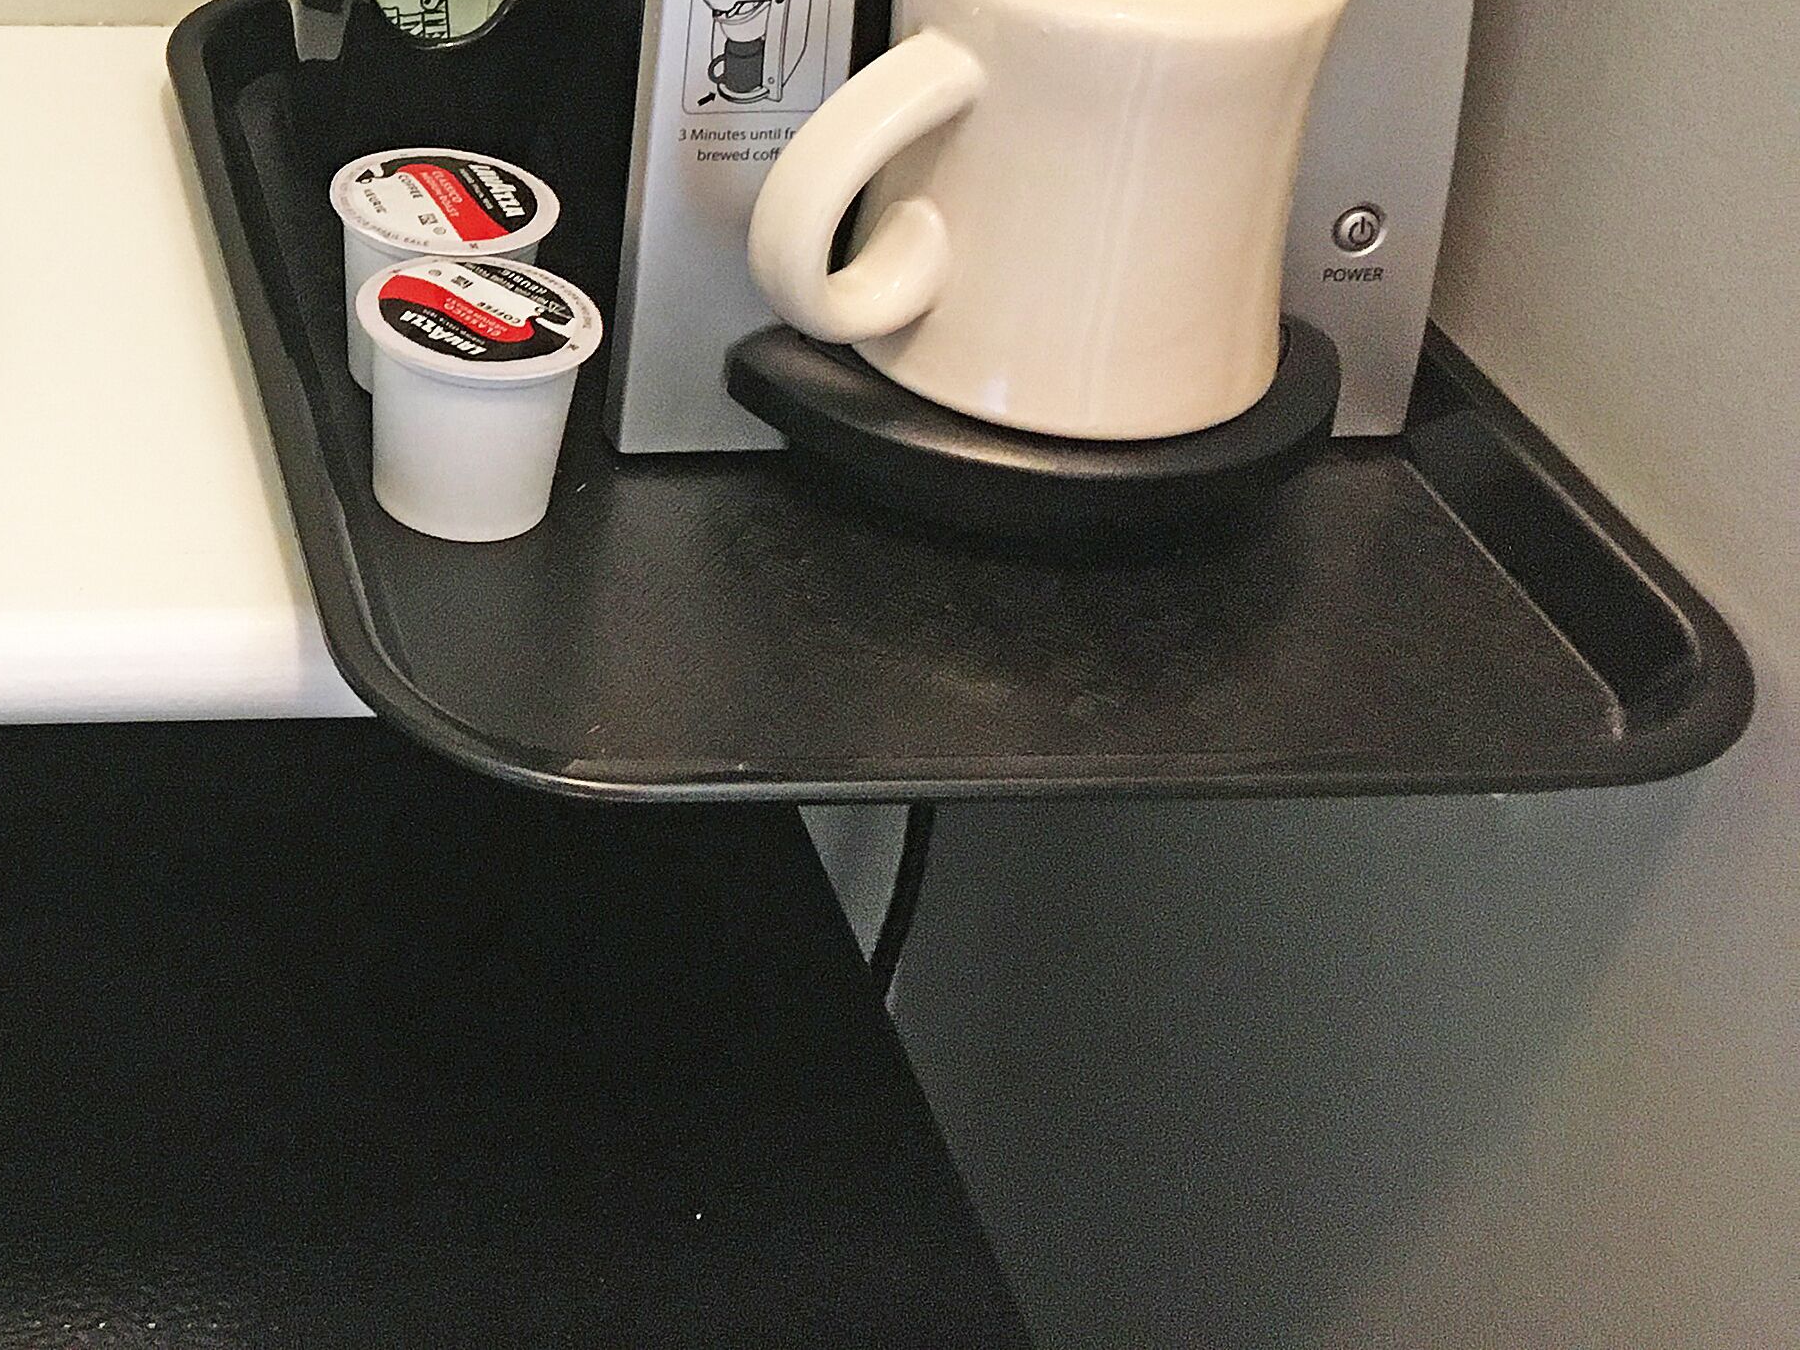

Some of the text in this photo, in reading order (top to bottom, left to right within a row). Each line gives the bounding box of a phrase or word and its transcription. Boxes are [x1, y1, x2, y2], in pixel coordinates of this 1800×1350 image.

[678, 129, 687, 142] 3
[690, 128, 746, 141] Minutes
[750, 127, 781, 140] until
[696, 149, 780, 162] brewed coff
[398, 174, 423, 199] COFFEE
[467, 164, 526, 218] LAVAZZA
[1322, 267, 1385, 282] POWER
[443, 303, 502, 337] CLASSICO
[477, 301, 521, 324] COFFEE
[400, 310, 487, 355] LAVAZZA
